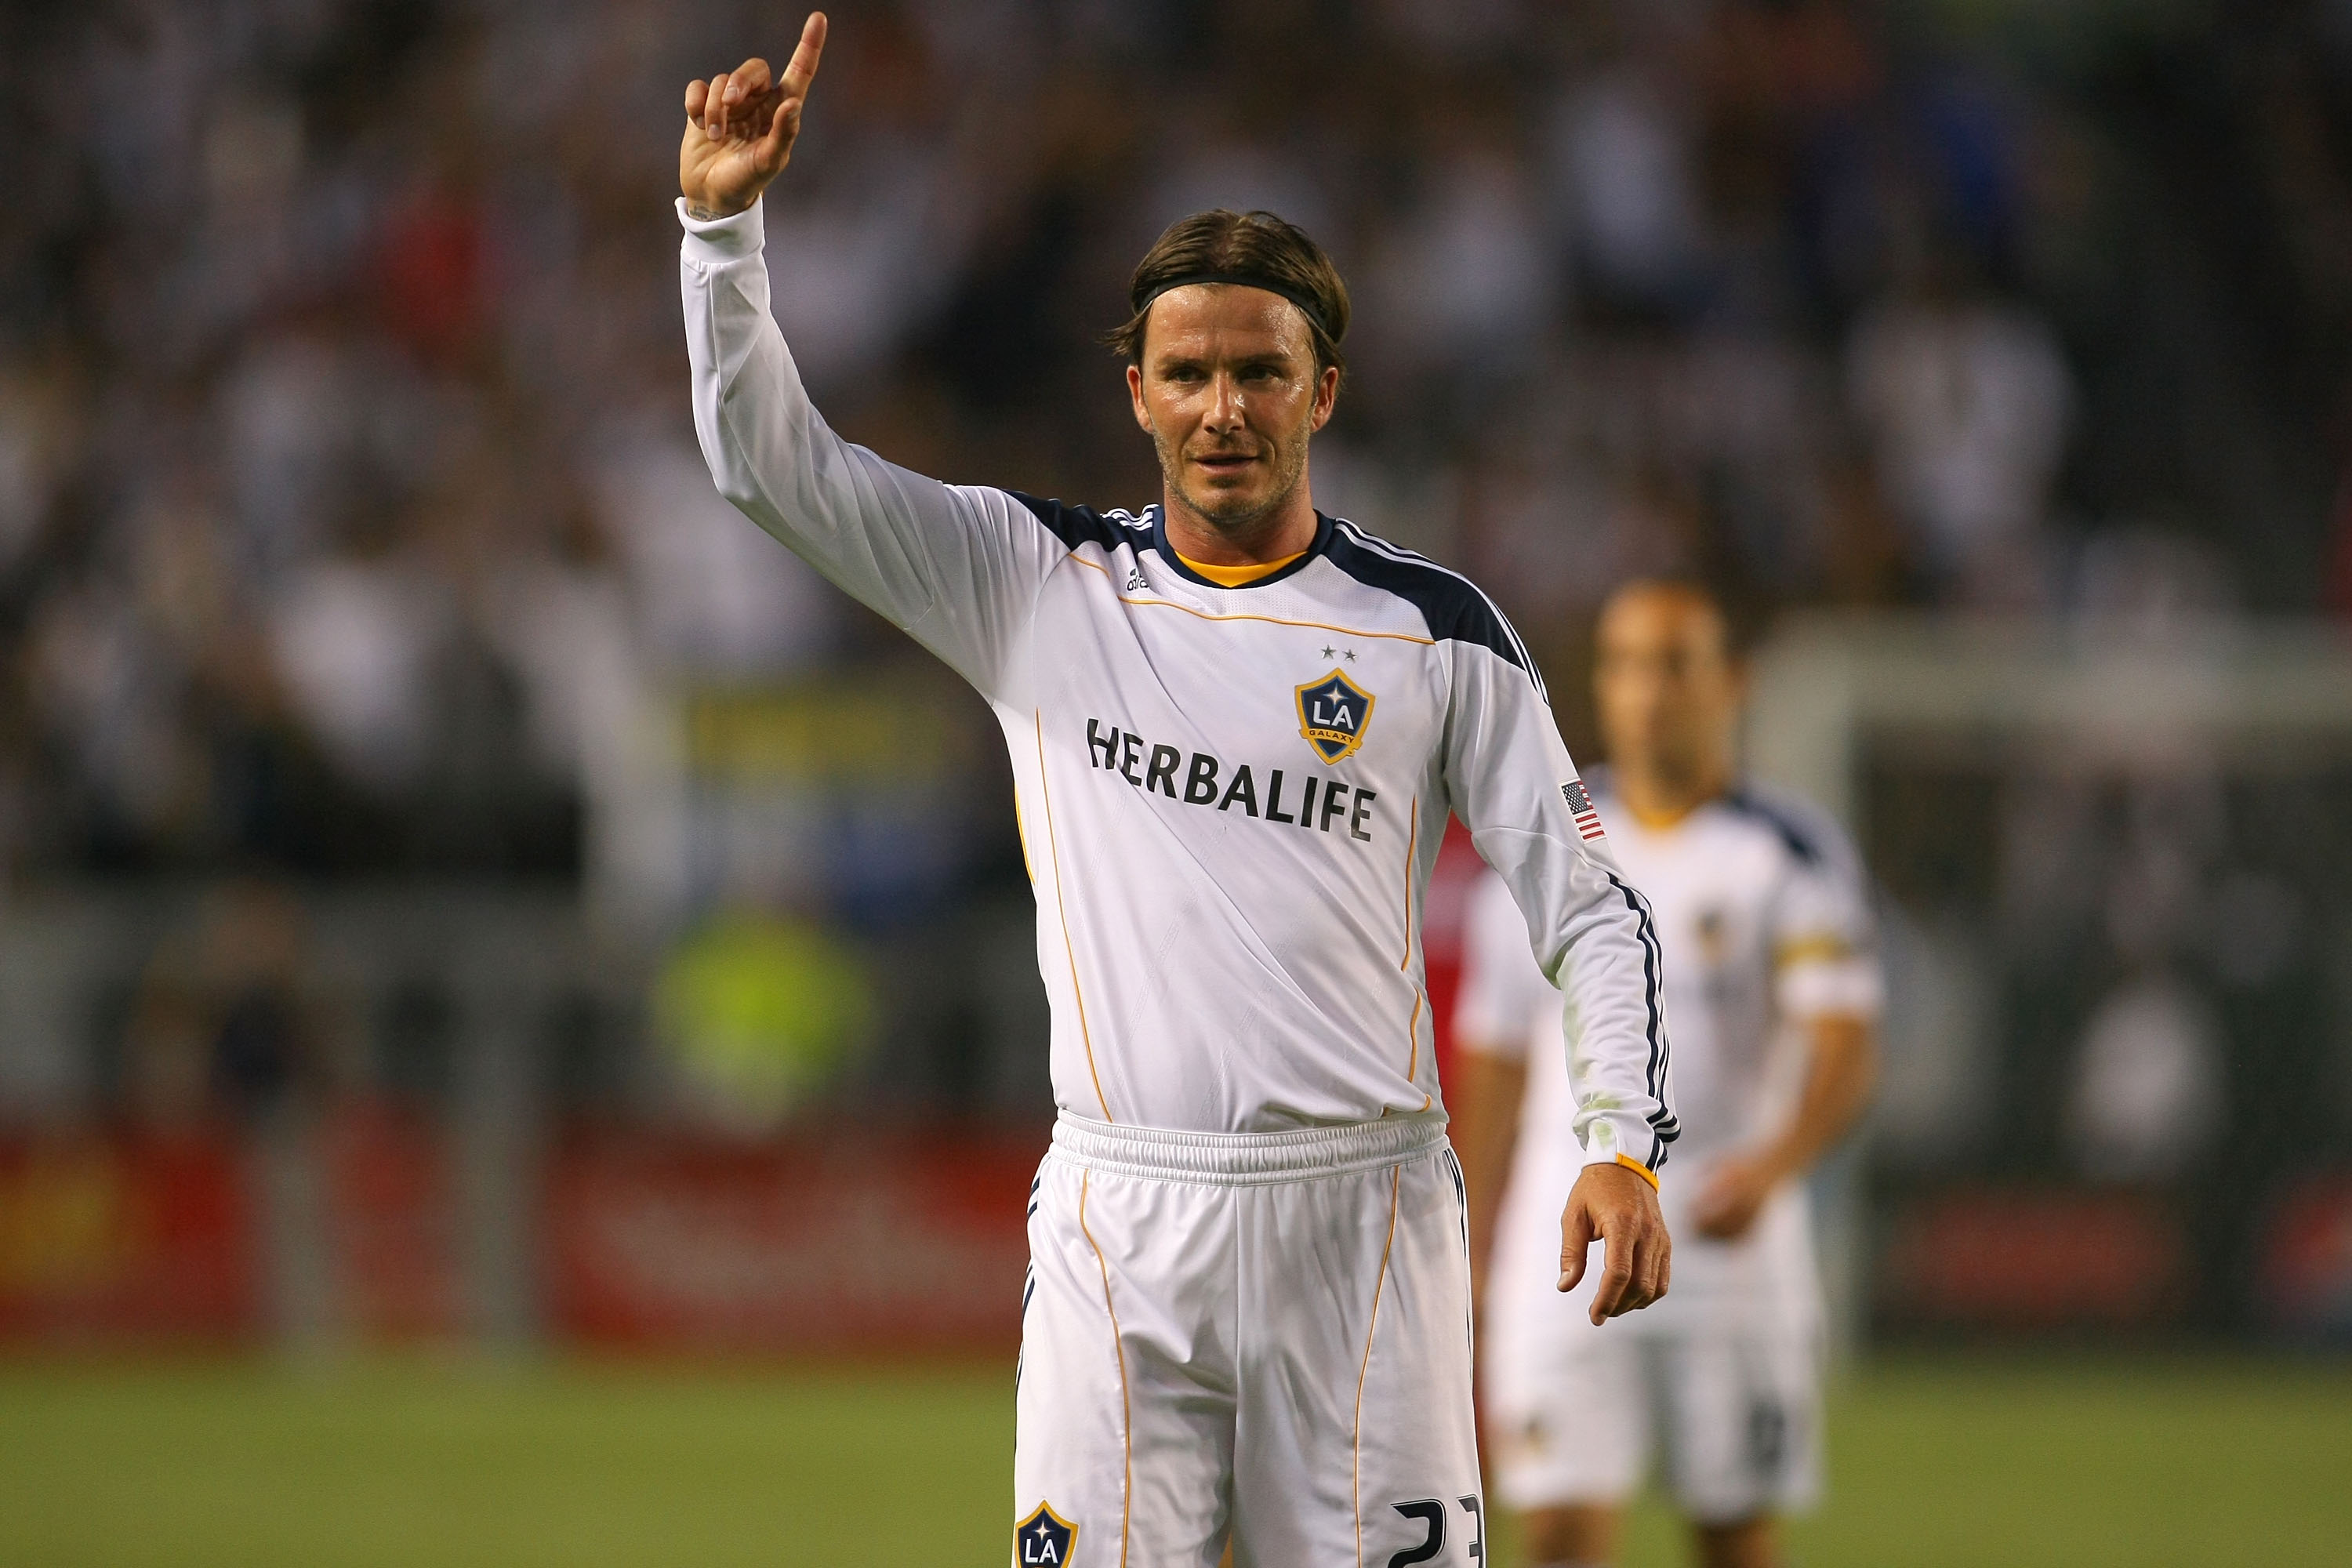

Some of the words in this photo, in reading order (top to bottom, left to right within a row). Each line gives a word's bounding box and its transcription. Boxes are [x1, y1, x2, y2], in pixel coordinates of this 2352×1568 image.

[1312, 700, 1355, 730] LA
[1308, 729, 1355, 744] GALAXY
[1087, 718, 1377, 843] HERBALIFE
[1025, 1538, 1058, 1564] LA
